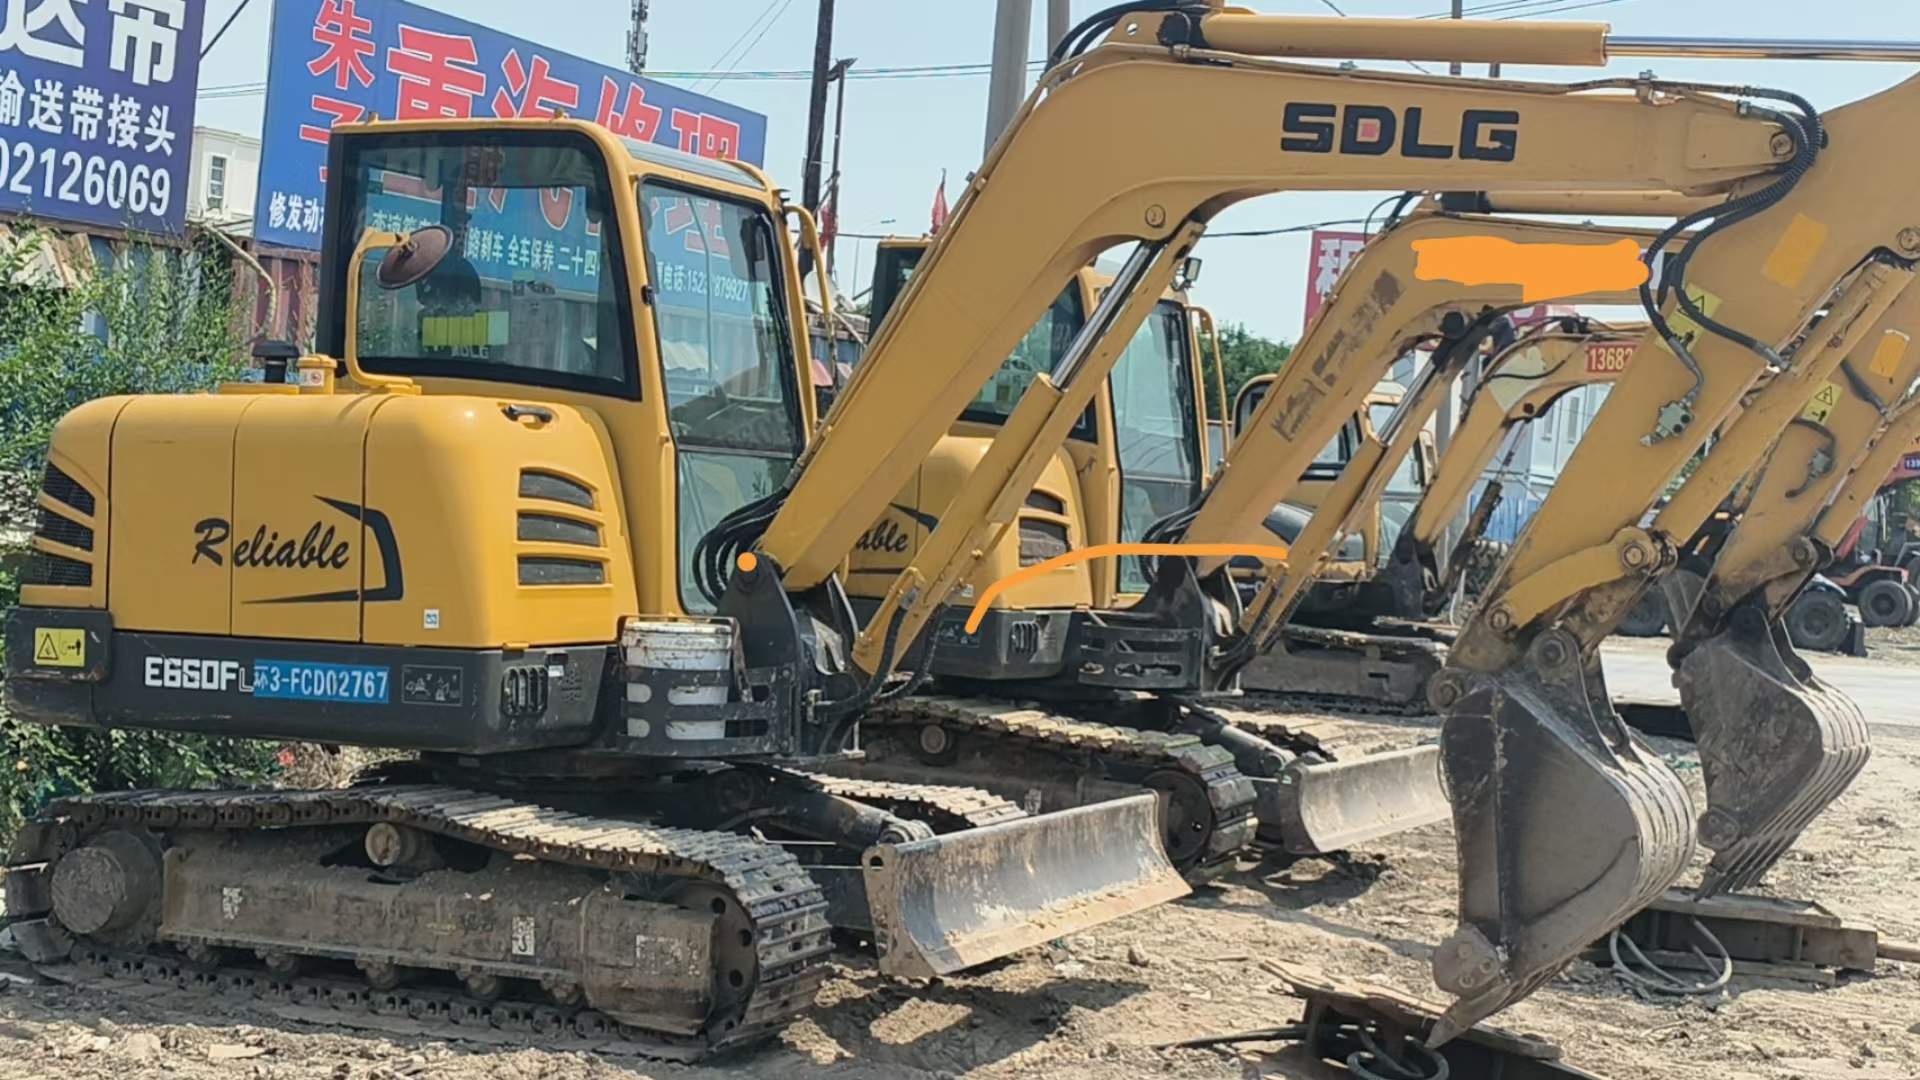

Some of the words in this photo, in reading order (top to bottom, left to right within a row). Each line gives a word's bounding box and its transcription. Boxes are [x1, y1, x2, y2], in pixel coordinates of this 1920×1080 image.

[1280, 101, 1520, 163] SDLG
[268, 190, 325, 234] 修发动
[458, 226, 505, 264] 路刹车
[507, 233, 555, 273] 全车保养
[557, 244, 601, 278] 二十四
[192, 517, 350, 569] Reliable
